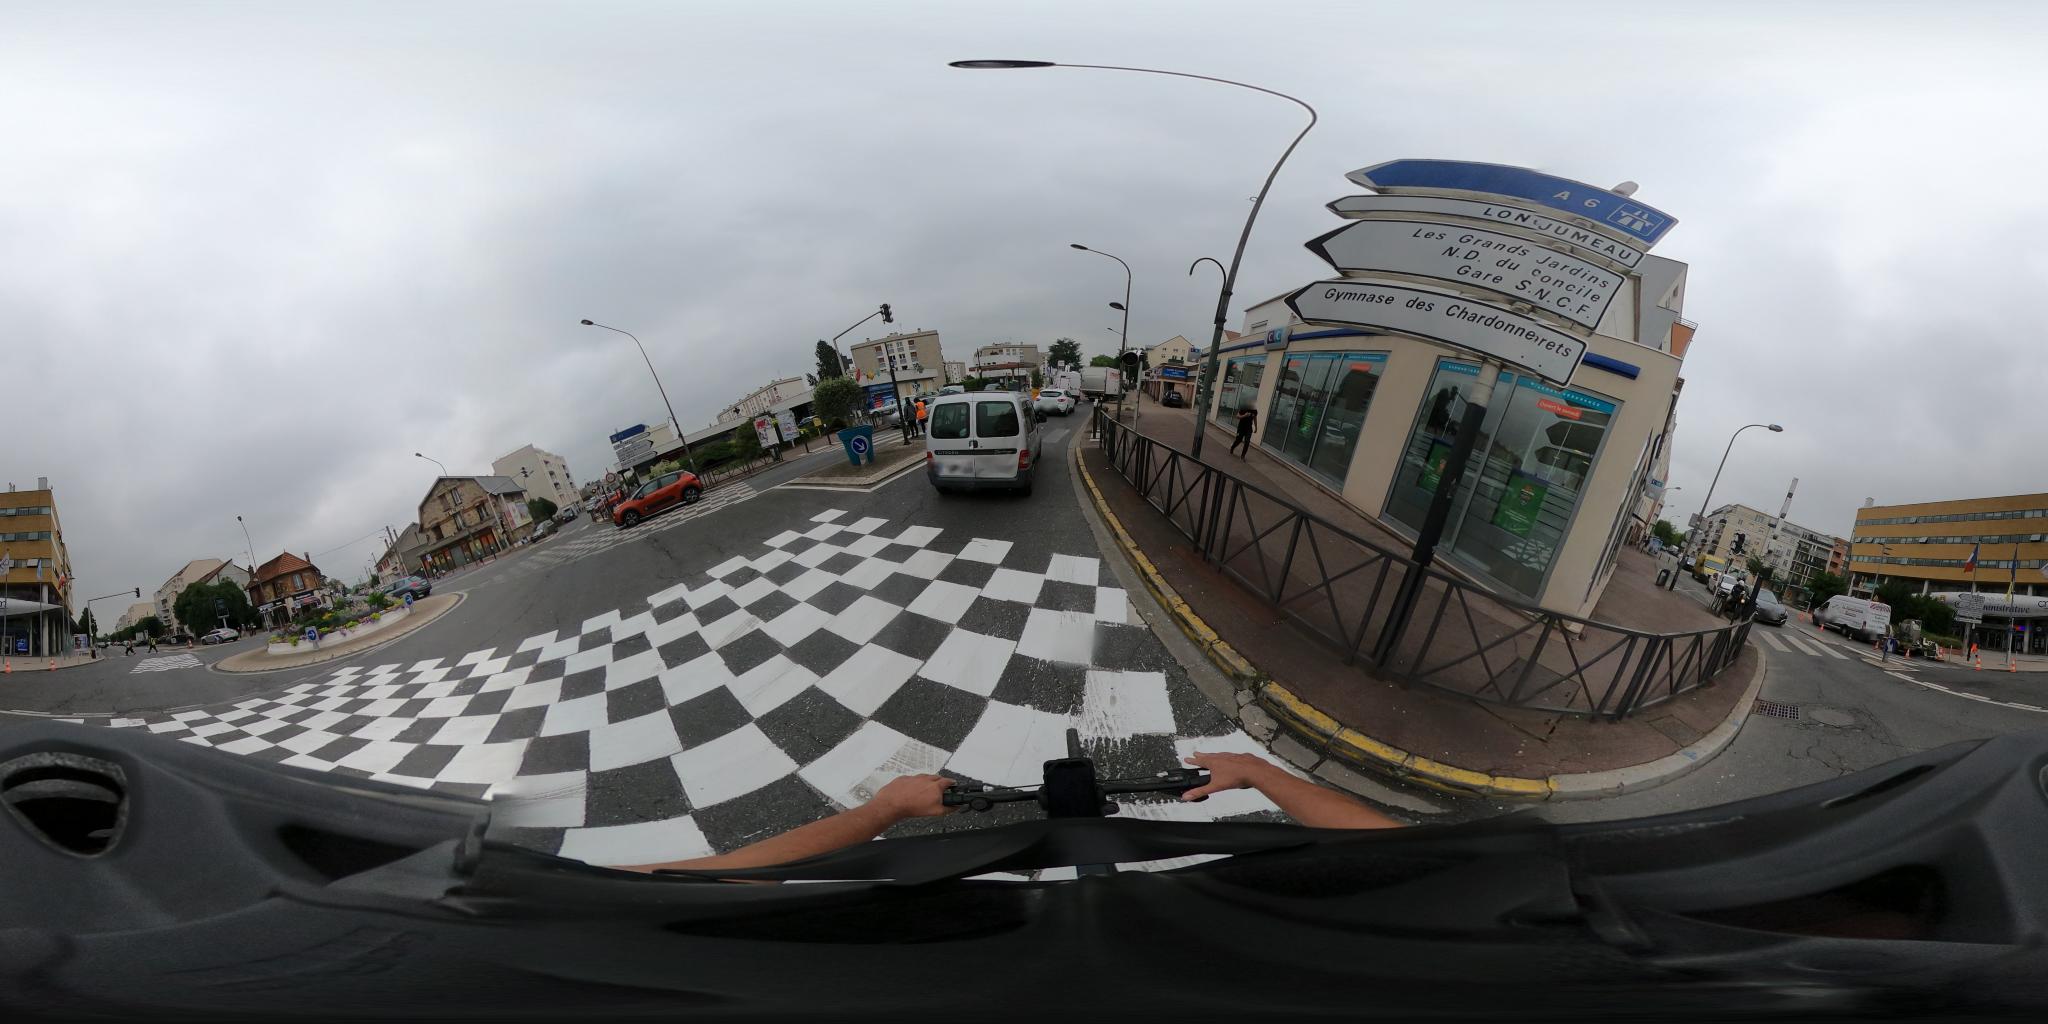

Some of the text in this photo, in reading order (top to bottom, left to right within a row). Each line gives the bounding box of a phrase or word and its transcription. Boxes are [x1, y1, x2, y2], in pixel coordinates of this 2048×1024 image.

[1553, 190, 1600, 208] A 6
[1412, 227, 1609, 289] Les Grands Jardins
[1483, 207, 1632, 261] LONJUMEAU
[1441, 246, 1601, 303] N.D. du concile
[1456, 265, 1591, 319] Gare S.N.C.F.
[1323, 287, 1573, 358] Gymnase des Chardonnerets
